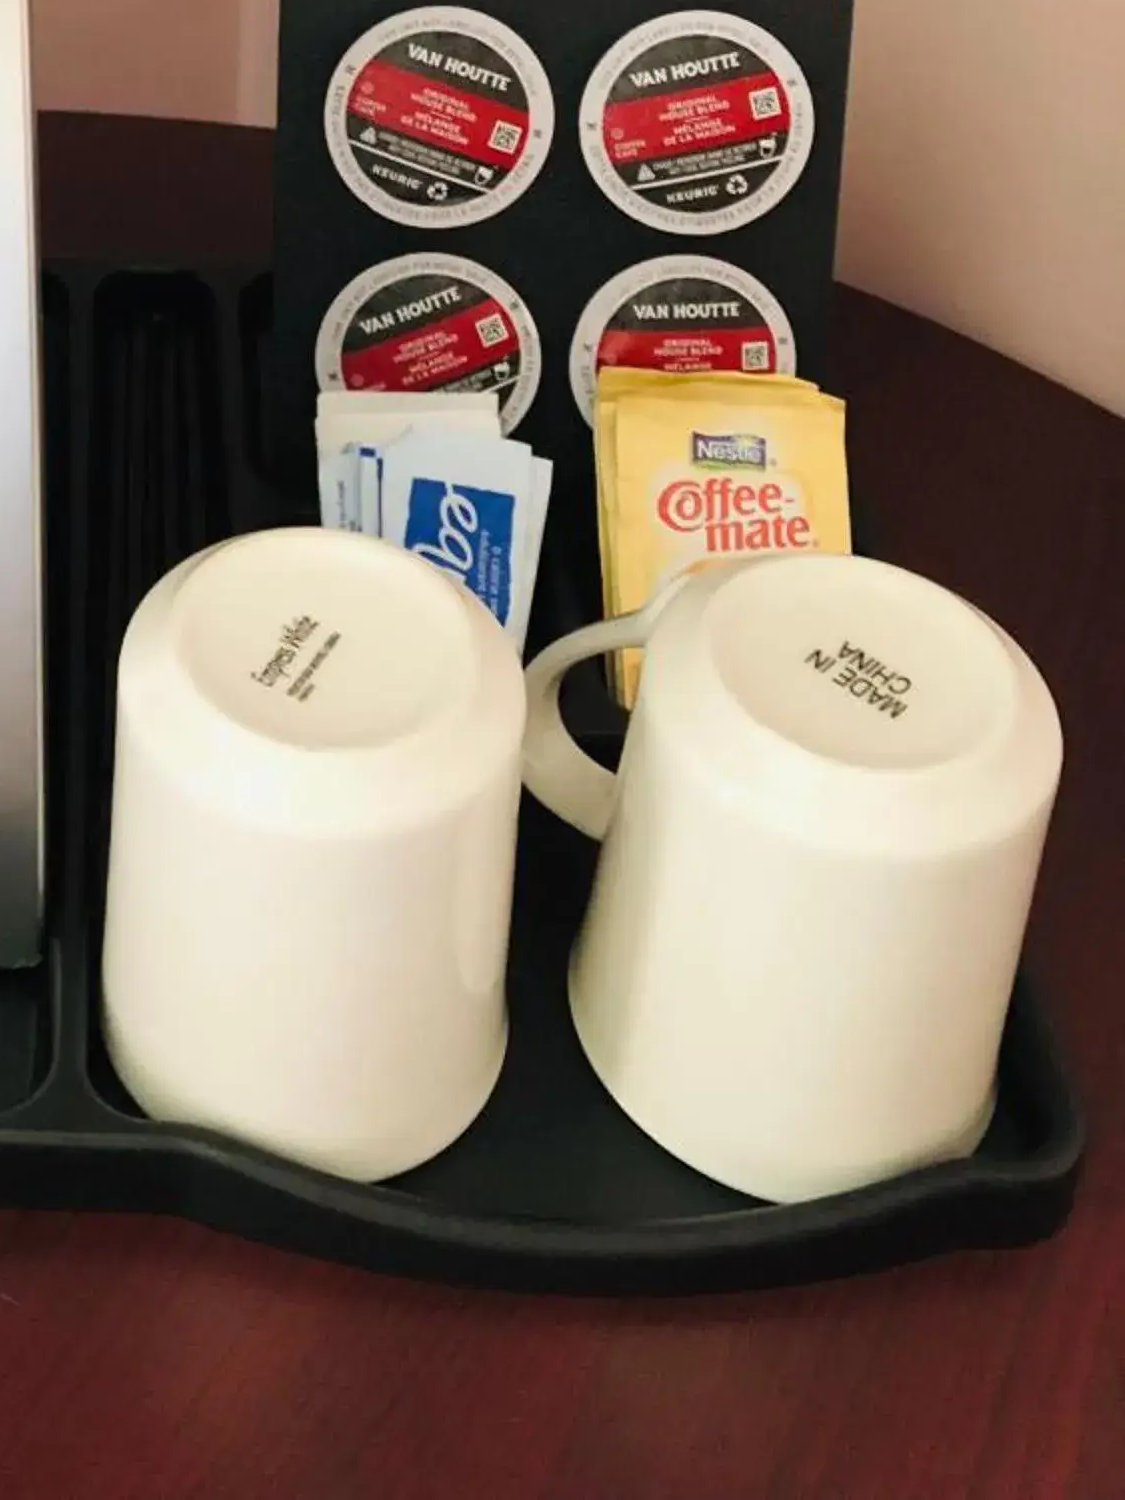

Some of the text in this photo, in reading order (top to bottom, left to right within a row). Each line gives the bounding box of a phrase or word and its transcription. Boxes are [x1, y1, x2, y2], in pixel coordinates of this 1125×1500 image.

[408, 42, 440, 67] VAN
[444, 58, 512, 92] HOUTTE
[629, 52, 741, 88] VAN HOUTTE
[372, 164, 423, 191] KEURIG
[666, 184, 719, 204] KEURIG
[359, 312, 396, 334] VAN
[396, 285, 462, 323] HOUTTE
[633, 301, 741, 320] VAN HOUTTE
[657, 477, 795, 533] Coffee-
[705, 514, 811, 552] mate
[804, 649, 908, 718] MADE IN
[838, 641, 912, 695] CHINA
